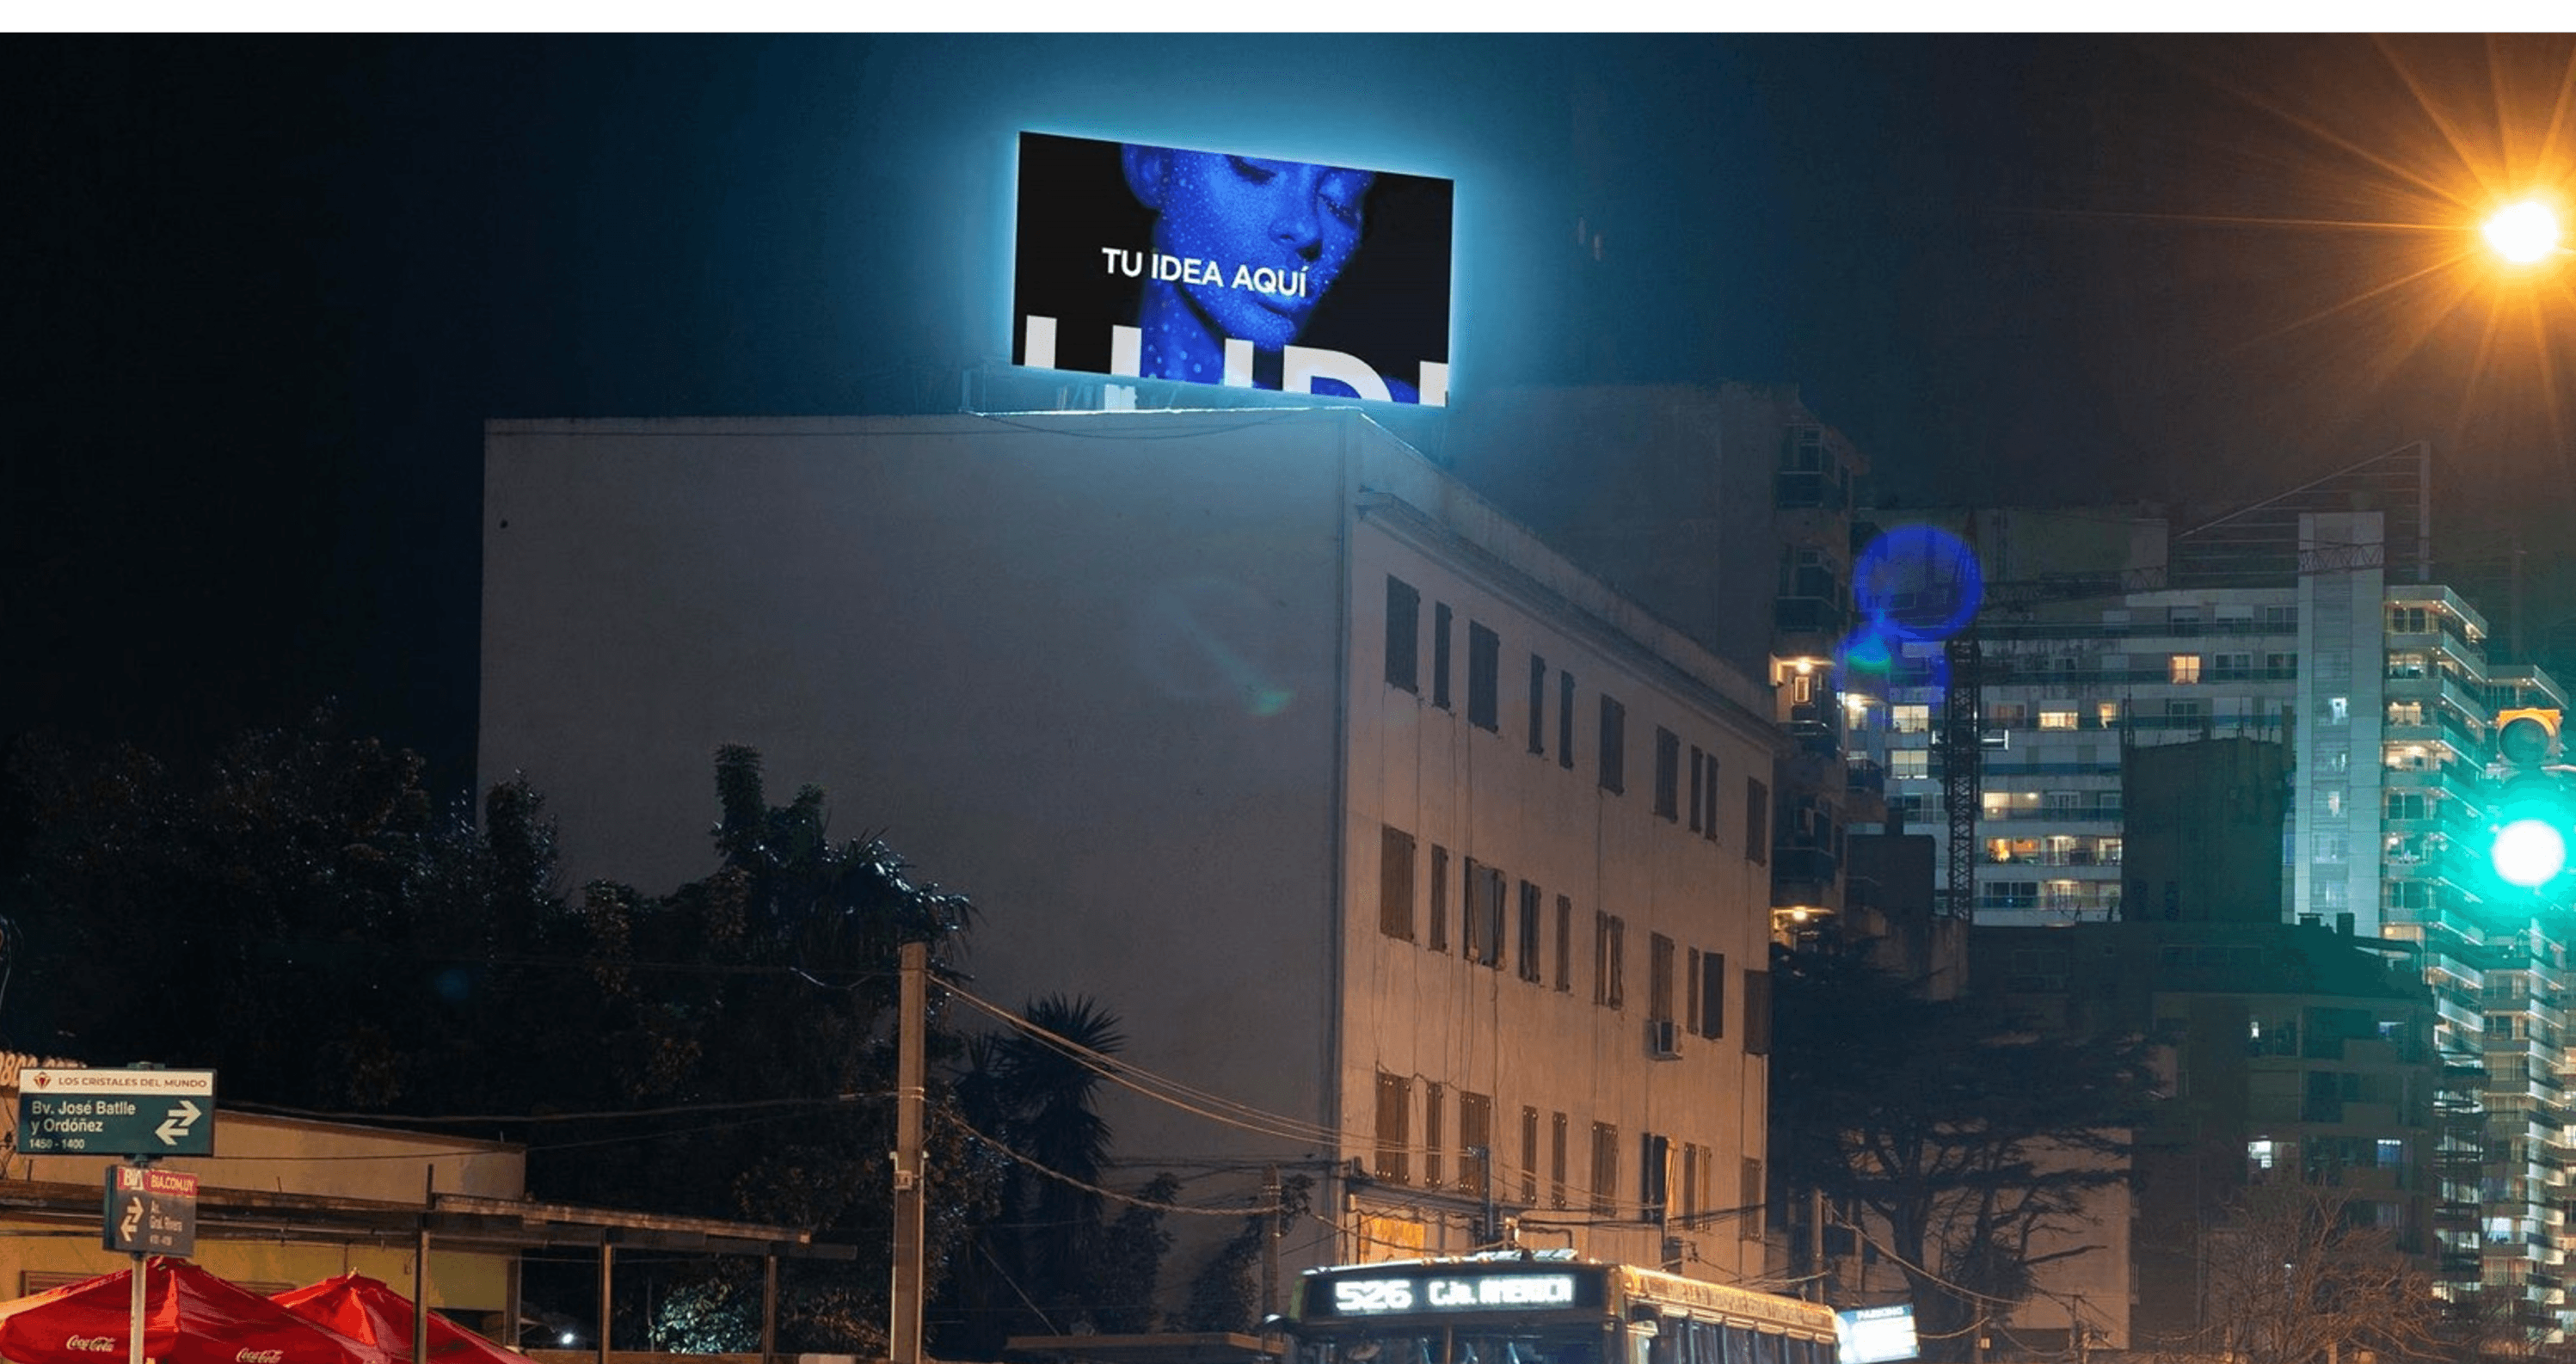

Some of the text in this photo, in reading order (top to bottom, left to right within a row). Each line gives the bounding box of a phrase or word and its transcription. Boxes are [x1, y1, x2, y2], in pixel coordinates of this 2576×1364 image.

[1102, 246, 1308, 298] TU IDEA AQUÍ
[58, 1077, 207, 1088] LOS CRISTALES DEL MUNDO
[32, 1099, 136, 1115] Bv. José Batlle
[31, 1119, 103, 1135] y Ordóñez
[29, 1139, 52, 1149] 1450
[62, 1139, 85, 1149] 1400
[1336, 1279, 1413, 1310] 526
